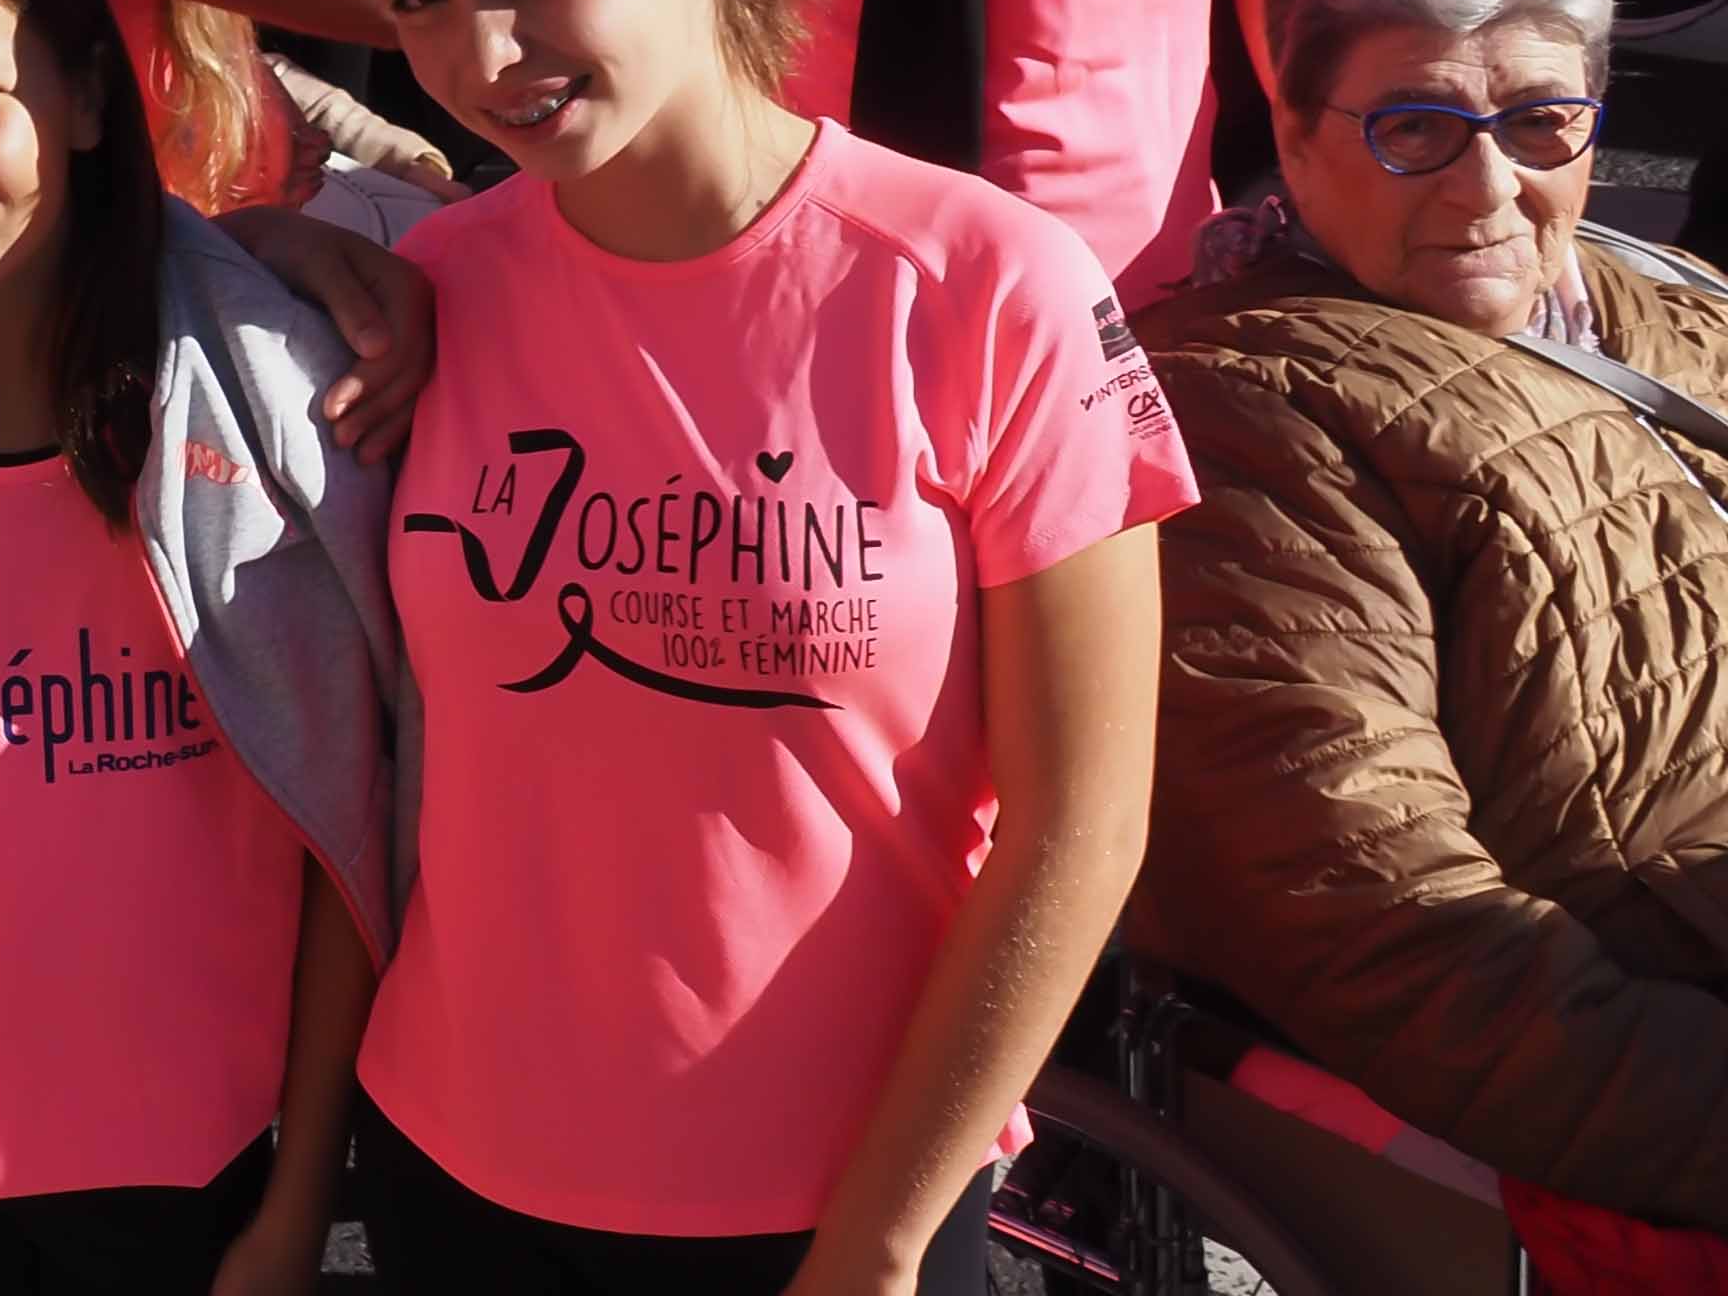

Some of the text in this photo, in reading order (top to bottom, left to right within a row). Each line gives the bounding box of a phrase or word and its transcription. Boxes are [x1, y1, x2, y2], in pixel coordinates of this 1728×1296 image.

[404, 428, 884, 602] LA JOSÉPHINE
[609, 589, 879, 635] COURSE ET MARCHE
[740, 632, 878, 677] FÉMININE
[68, 759, 95, 776] La
